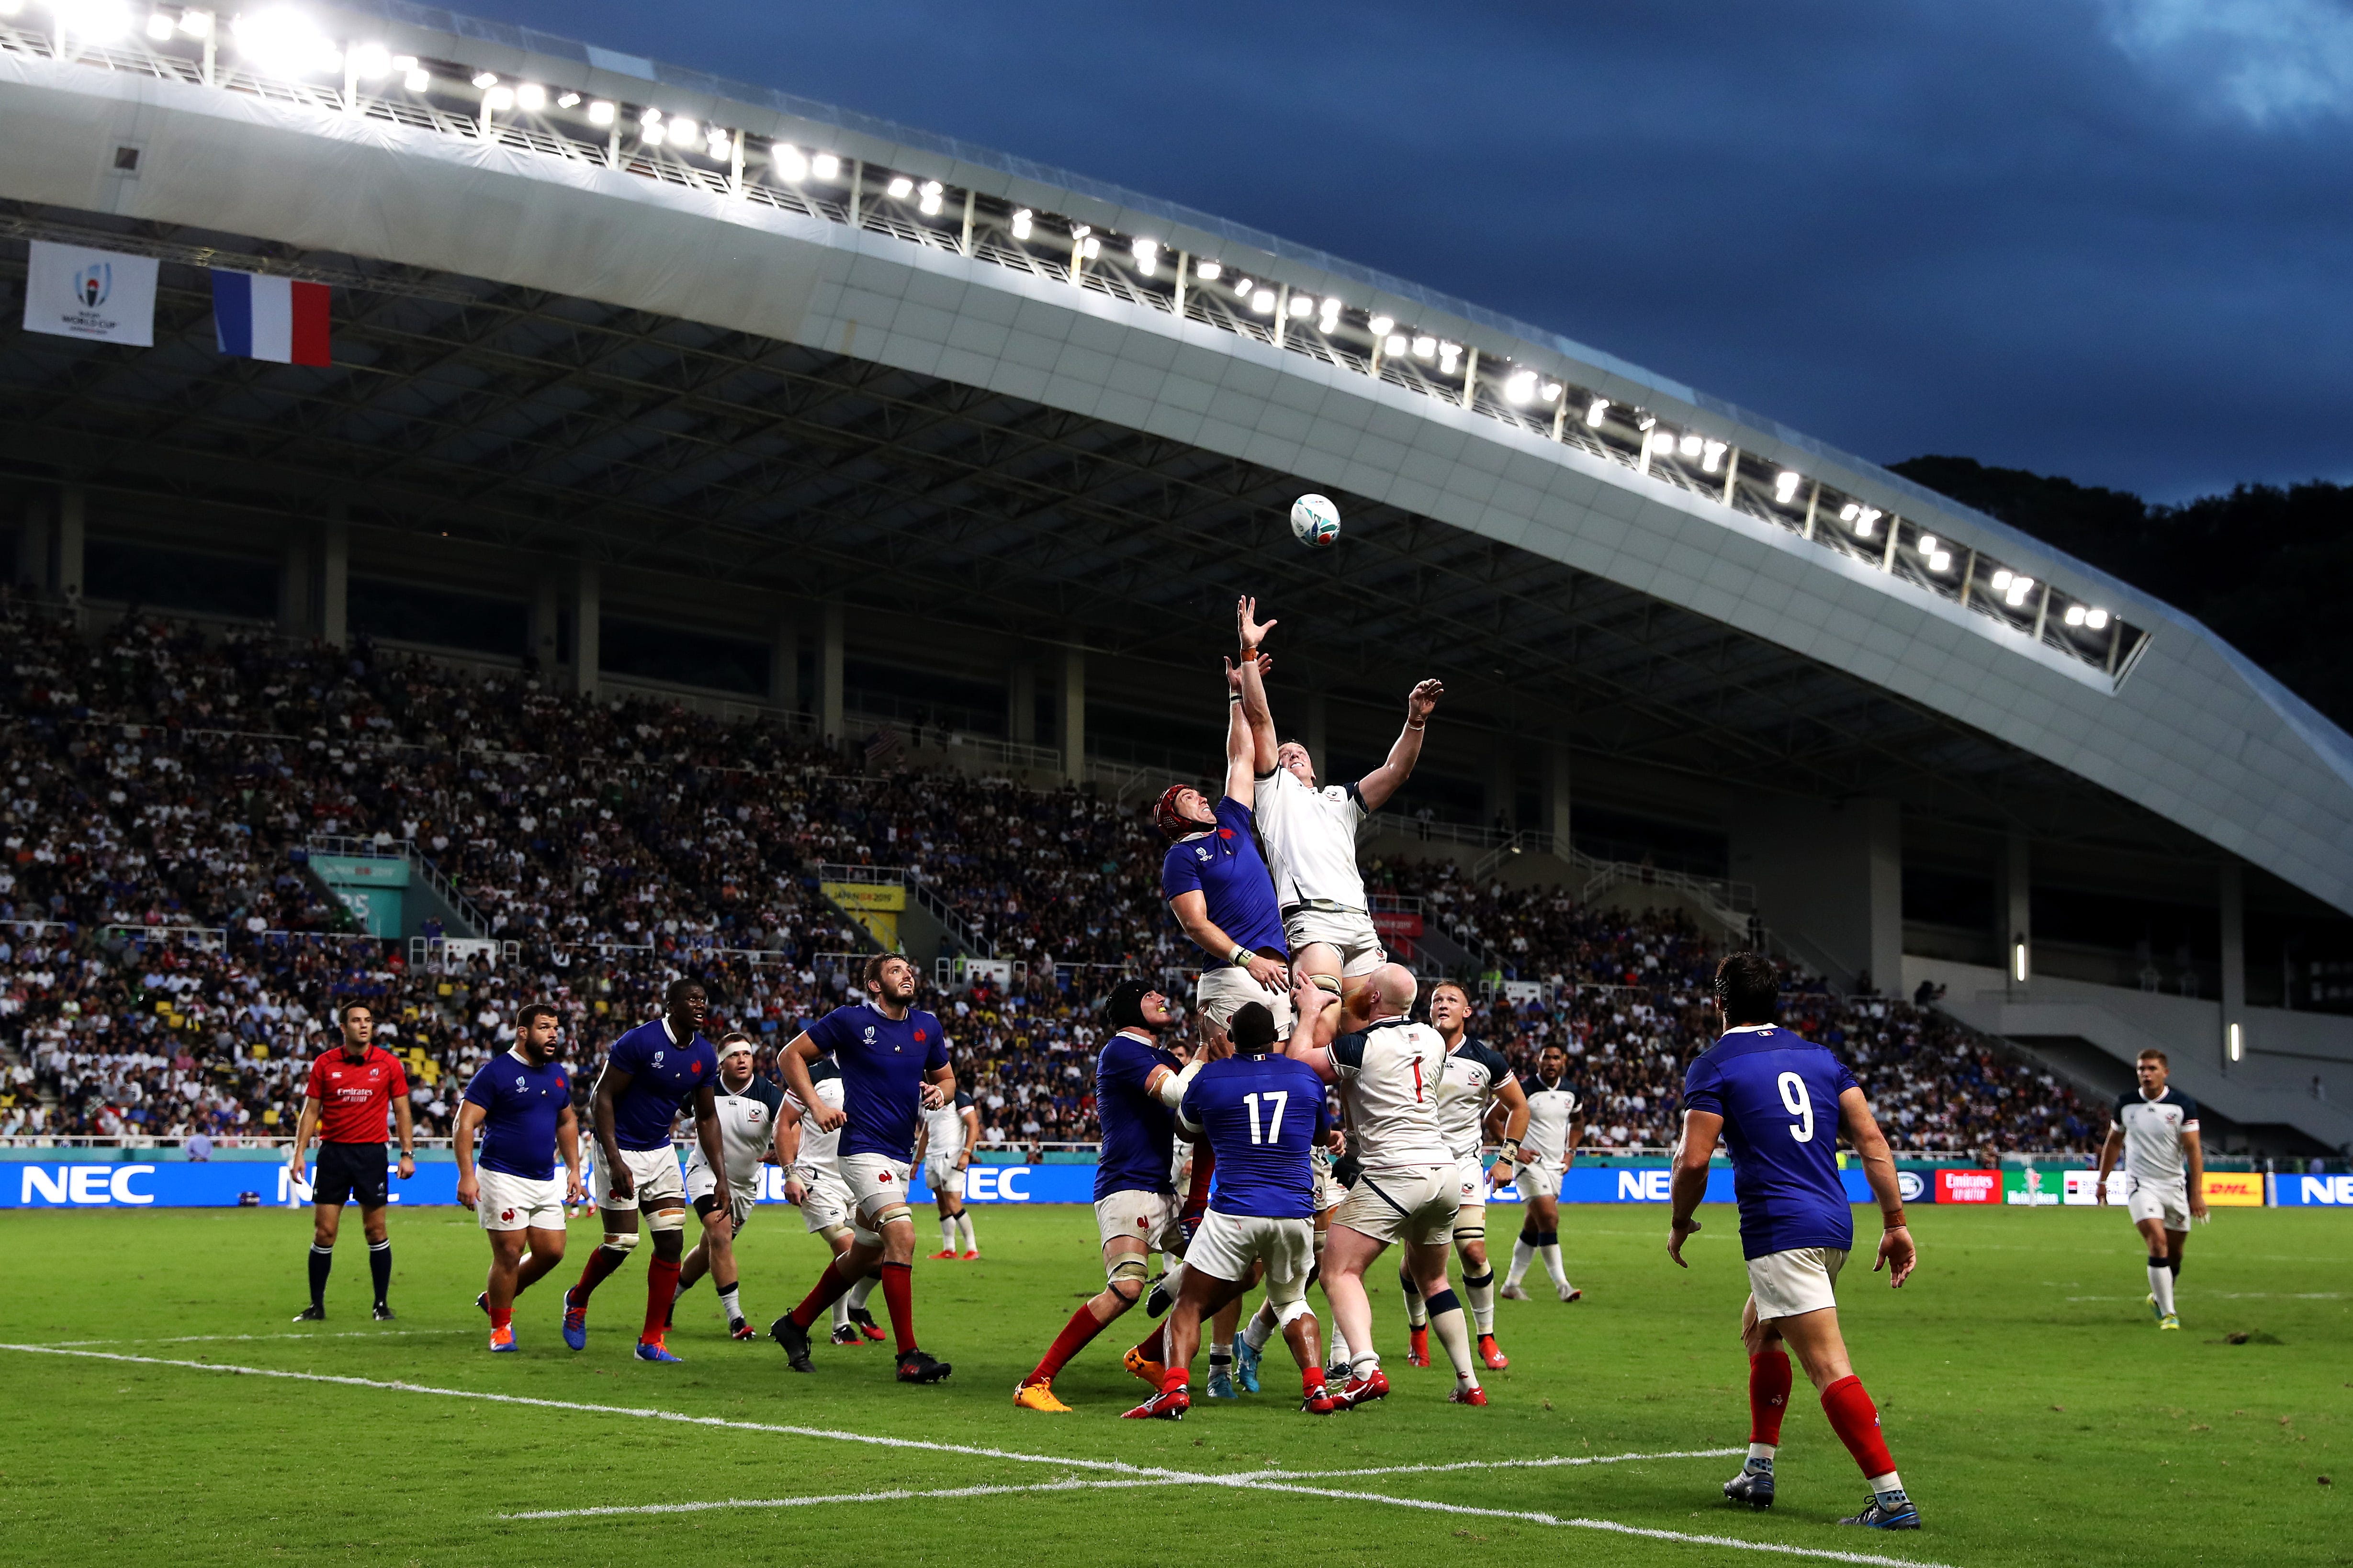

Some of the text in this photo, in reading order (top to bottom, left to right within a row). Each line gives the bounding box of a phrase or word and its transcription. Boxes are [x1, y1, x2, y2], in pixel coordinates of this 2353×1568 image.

[337, 1087, 373, 1096] Emirates
[1412, 1056, 1423, 1103] 1
[1243, 1091, 1288, 1144] 17
[1777, 1071, 1814, 1142] 9
[21, 1165, 155, 1204] NEC
[1618, 1171, 1672, 1200] NE
[1945, 1173, 1993, 1189] Emirates
[2208, 1184, 2249, 1194] DHL
[2301, 1176, 2353, 1204] NE
[2007, 1190, 2059, 1205] Heinken
